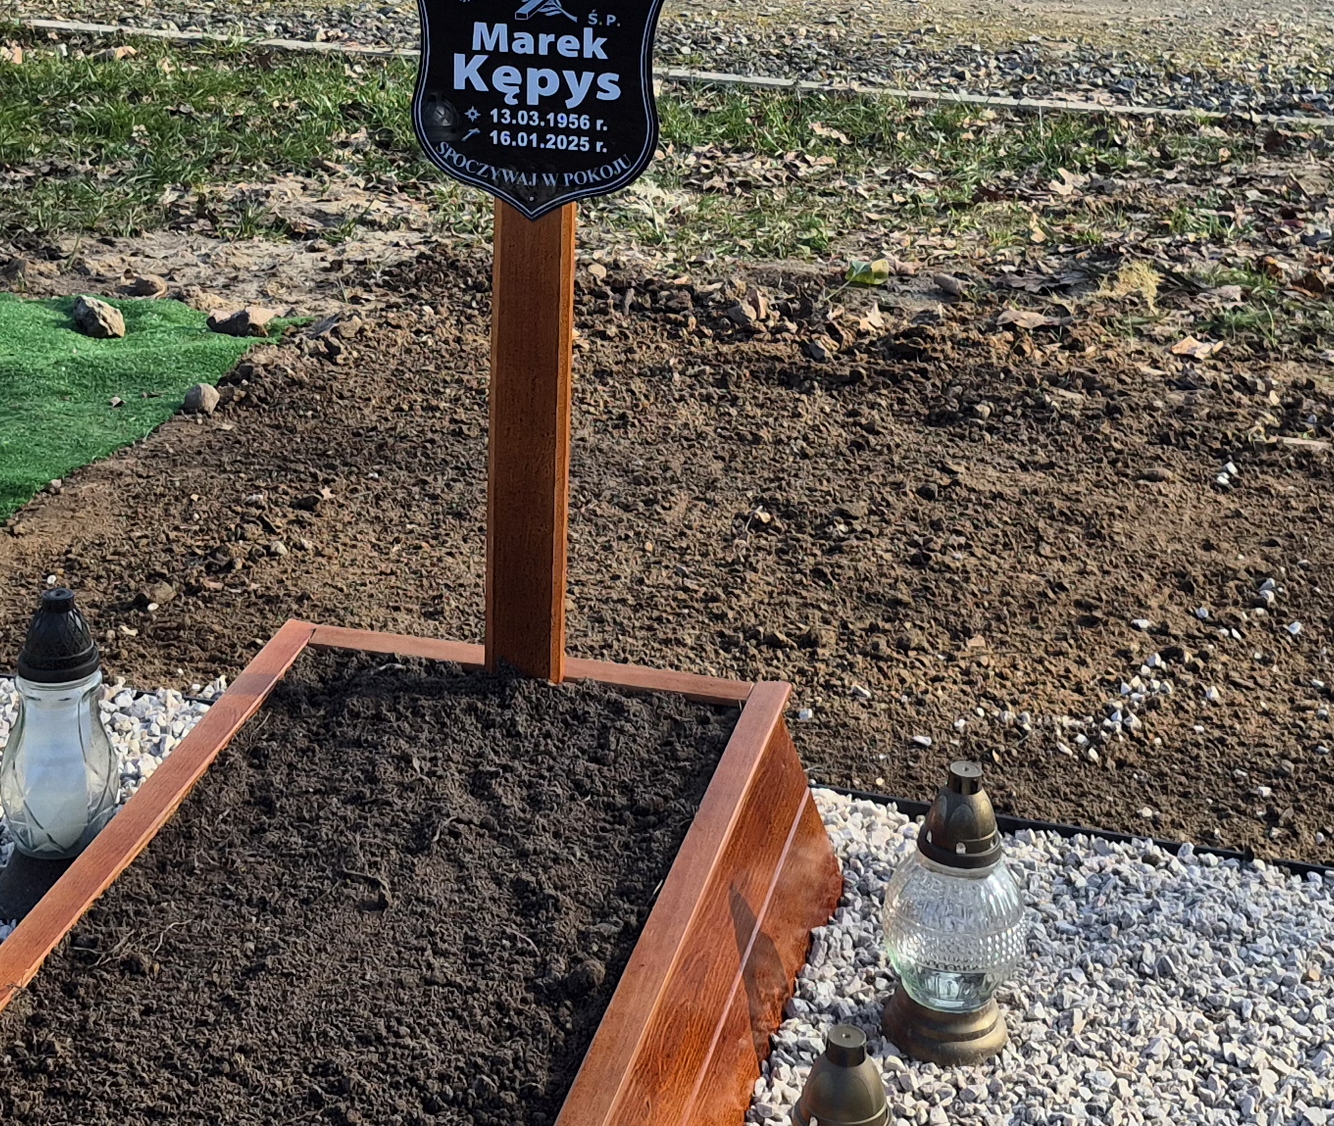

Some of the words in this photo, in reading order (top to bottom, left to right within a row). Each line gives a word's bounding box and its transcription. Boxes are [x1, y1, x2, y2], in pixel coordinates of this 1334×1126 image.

[471, 21, 609, 60] Marek
[453, 53, 622, 109] Kępys
[489, 108, 590, 131] 13.03.1956
[596, 119, 608, 131] r.
[489, 130, 590, 152] 16.01.2025
[596, 141, 608, 153] r.
[435, 140, 538, 187] SPOCZYWAJ
[542, 173, 559, 187] W
[564, 154, 633, 187] POKOJU
